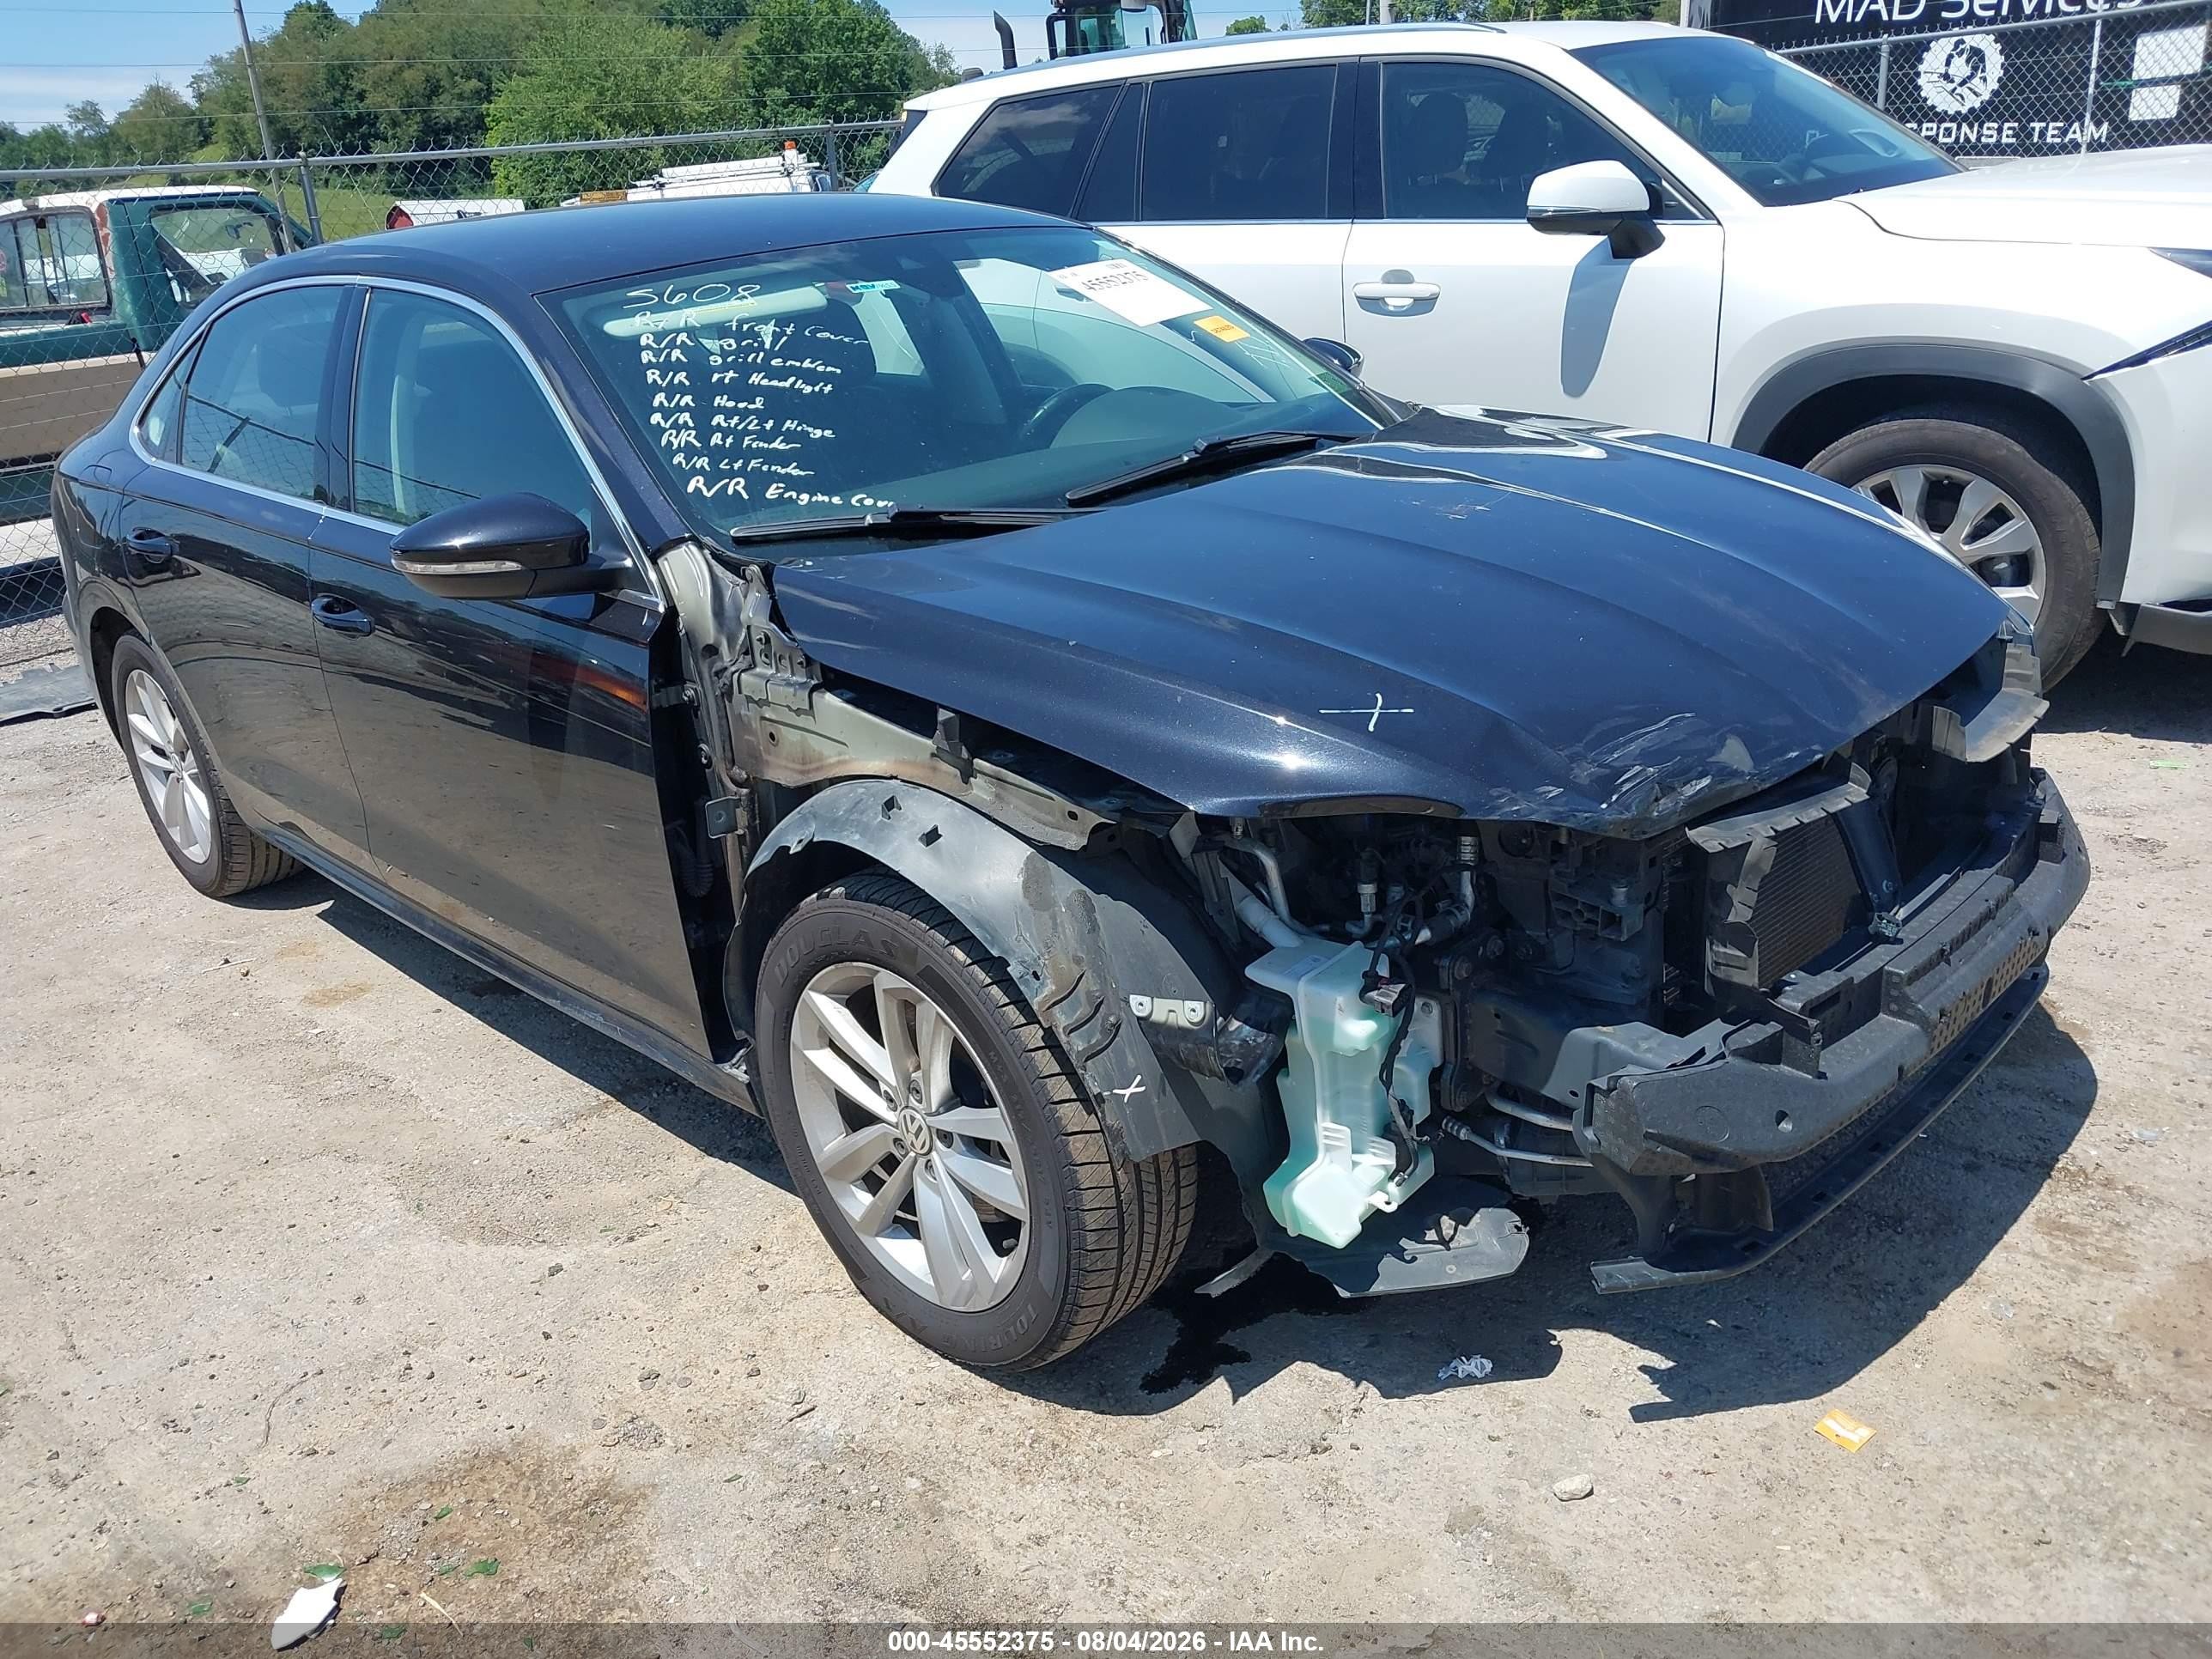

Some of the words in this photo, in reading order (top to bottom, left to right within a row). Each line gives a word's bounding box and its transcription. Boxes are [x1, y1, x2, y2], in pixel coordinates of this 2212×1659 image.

[1815, 0, 1926, 23] MAD
[2030, 122, 2109, 143] TEAM
[1080, 270, 1149, 291] 45552375
[640, 332, 695, 349] R/R
[640, 348, 689, 364] R/R
[646, 368, 690, 387] R/R
[653, 392, 696, 408] R/R
[649, 412, 695, 428] R/R
[660, 428, 702, 450] R/R
[672, 452, 711, 471] R/R
[687, 475, 750, 500] R/R
[765, 483, 843, 506] Engine
[775, 925, 900, 988] DOUGLAS
